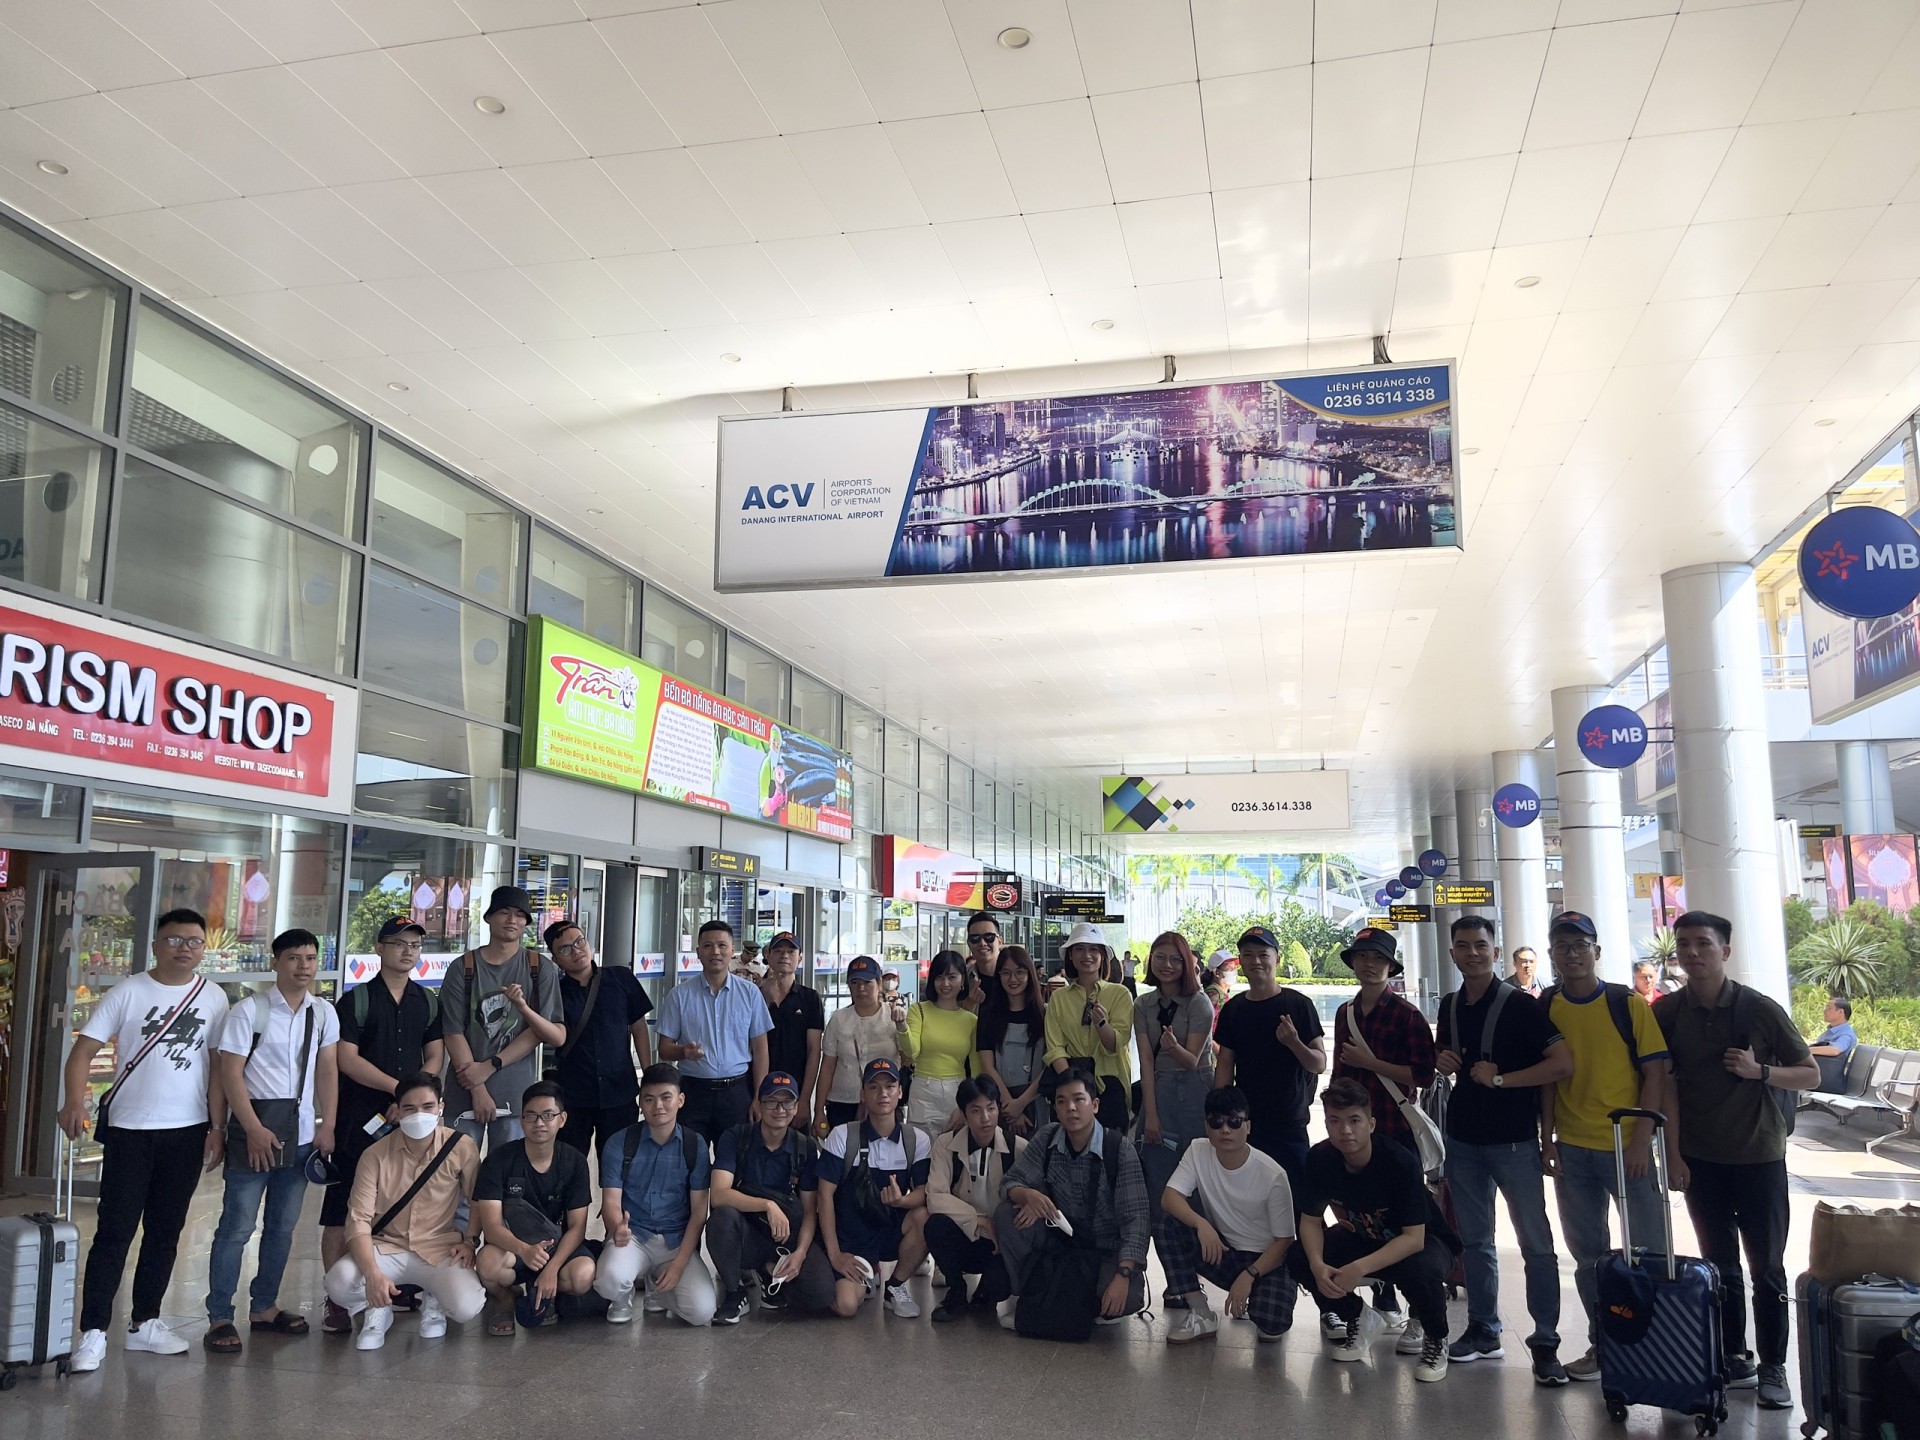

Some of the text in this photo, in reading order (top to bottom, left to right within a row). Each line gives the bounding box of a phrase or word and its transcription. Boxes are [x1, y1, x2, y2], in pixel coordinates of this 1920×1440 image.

[1327, 375, 1431, 392] LIÊN HỆ QUẢNG CÁO
[1323, 388, 1435, 409] 0236 3614 338
[831, 478, 872, 488] AIRPORTS
[741, 482, 815, 510] ACV
[830, 487, 891, 498] CORPORATION
[830, 496, 881, 507] OF VIETNAM
[741, 510, 884, 525] DANANG INTERNATIONAL AIRPORT
[1865, 543, 1920, 571] MB
[1812, 633, 1830, 659] ACV
[171, 676, 312, 753] SHOP
[737, 710, 750, 731] SẢN
[750, 716, 766, 737] TRẦN
[26, 718, 36, 732] ĐÀ
[39, 719, 59, 736] NẴNG
[72, 728, 89, 740] TEL:
[90, 732, 106, 744] 0236
[147, 742, 162, 754] FAX:
[1611, 727, 1643, 745] MB
[1231, 800, 1312, 812] 0236.3614.338
[1515, 799, 1537, 812] MB
[743, 857, 754, 873] A4
[1431, 859, 1446, 867] MB
